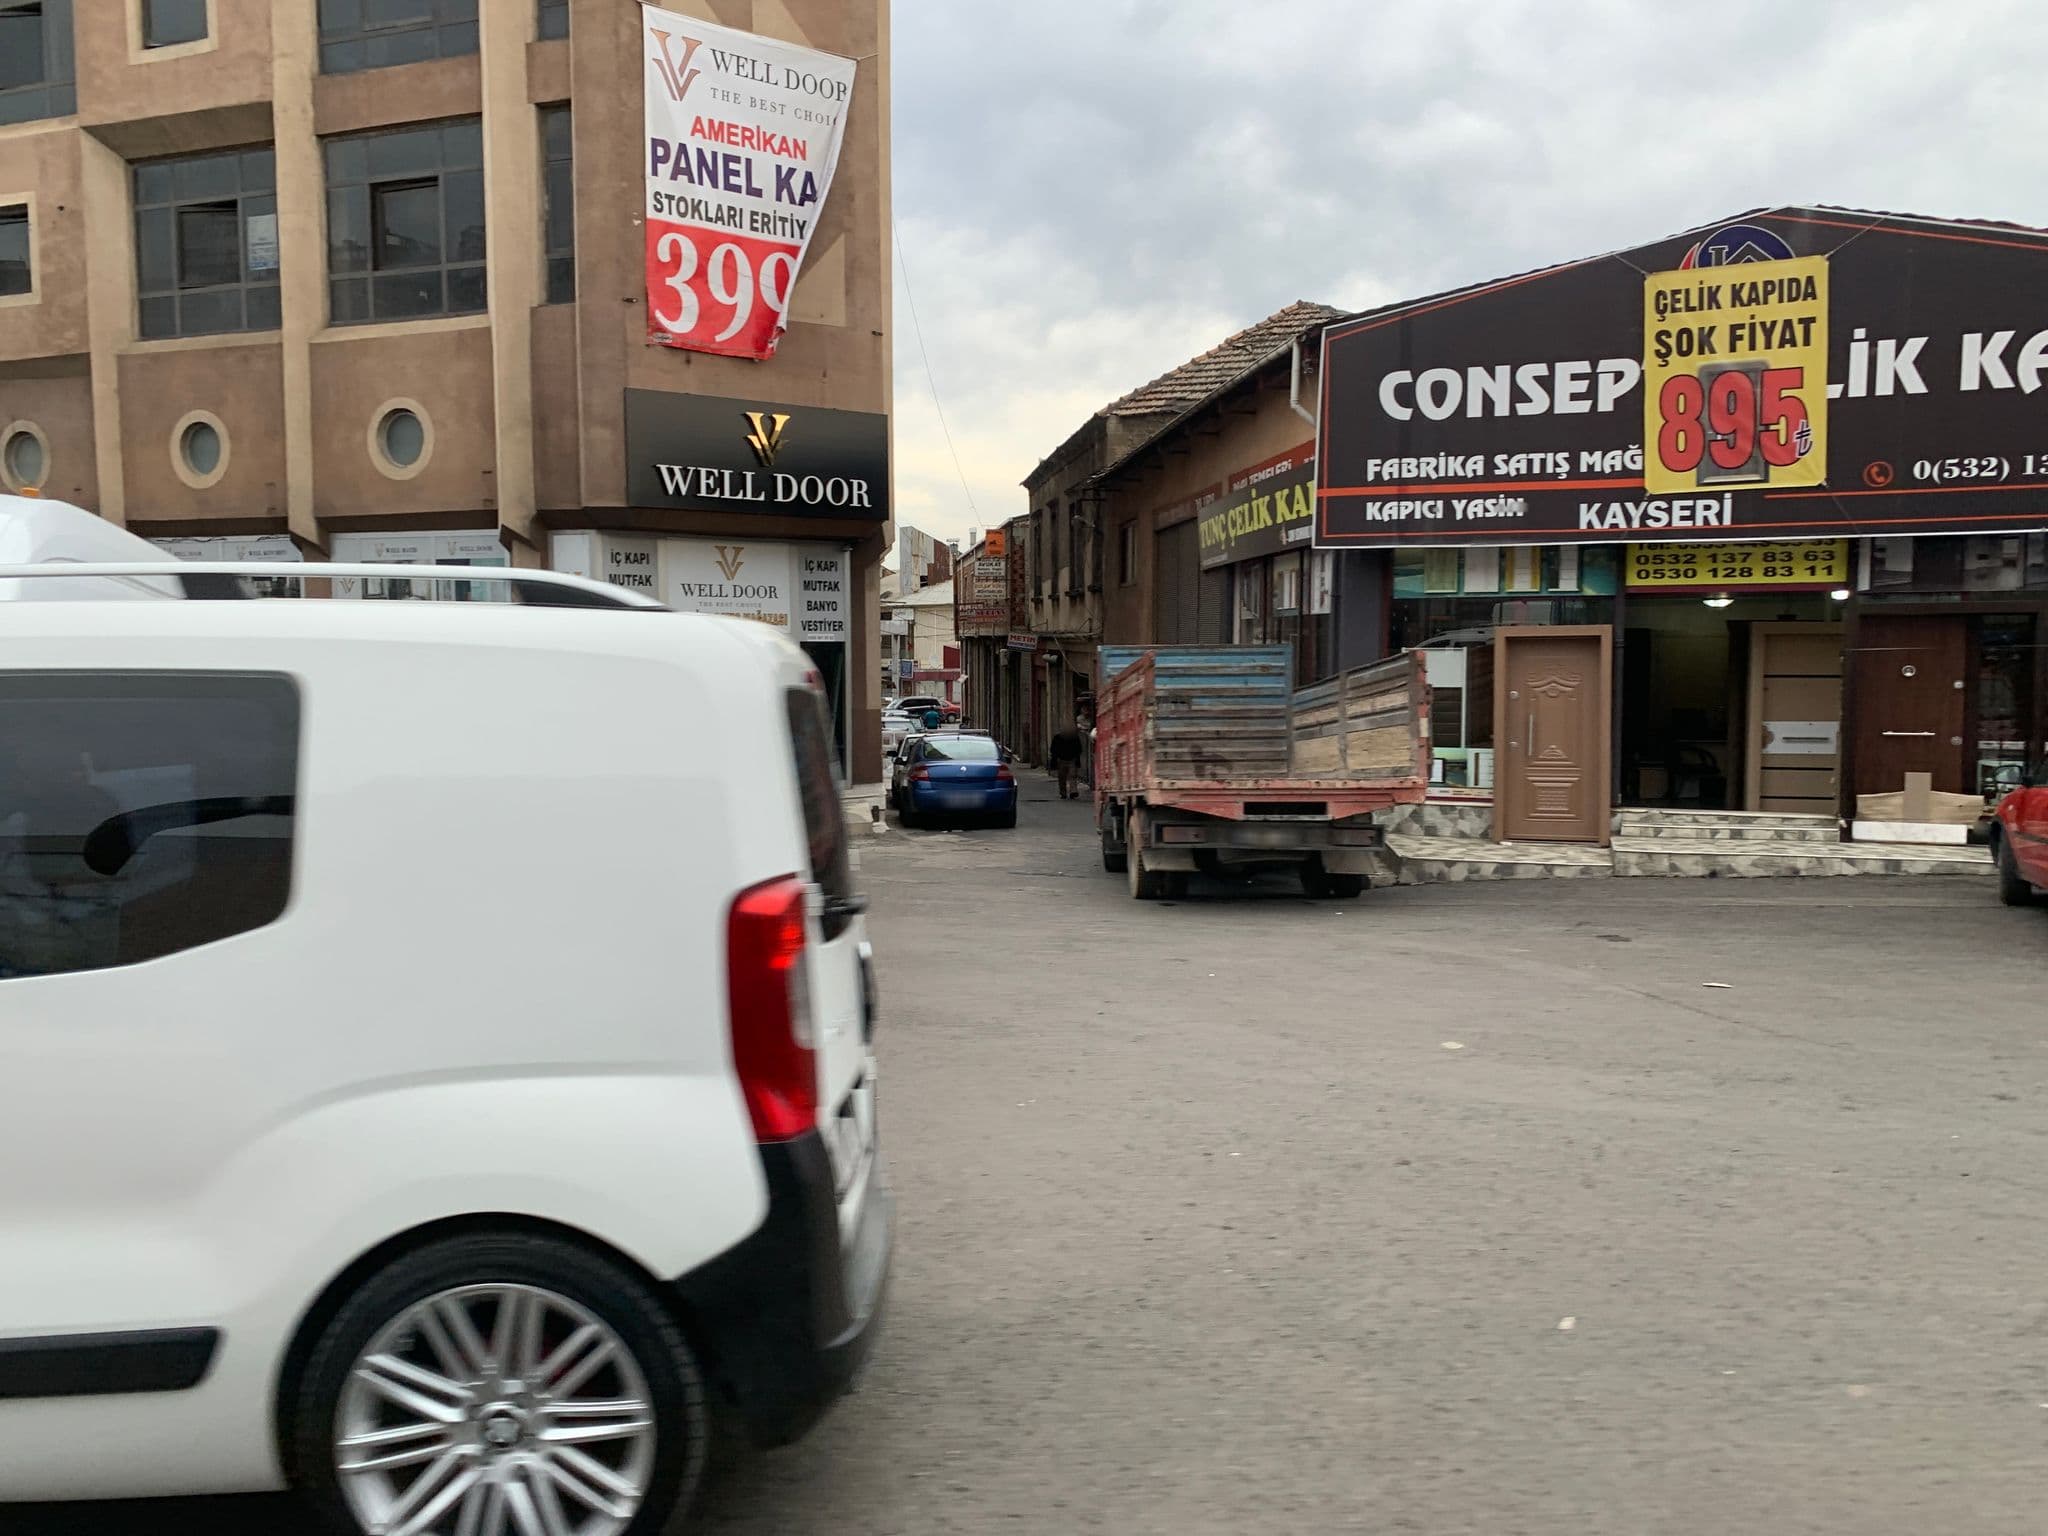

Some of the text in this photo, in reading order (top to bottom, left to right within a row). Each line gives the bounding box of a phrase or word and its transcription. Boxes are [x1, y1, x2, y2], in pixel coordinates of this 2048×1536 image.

[710, 49, 778, 86] WELL
[710, 87, 741, 105] THE
[750, 96, 787, 115] BEST
[690, 115, 807, 161] AMERİKAN
[650, 137, 763, 198] PANEL
[653, 191, 744, 229] STOKLARI
[1655, 276, 1818, 322] ÇELİK KAPIDA
[1654, 314, 1817, 367] ŞOK FİYAT
[1378, 358, 1645, 421] CONSEP
[1366, 451, 1485, 482] FABRİKA
[1493, 451, 1571, 479] SATIŞ
[1913, 456, 2010, 485] 0(532)
[656, 464, 872, 508] WELL DOOR
[1200, 513, 1227, 550] TUNÇ
[1228, 488, 1273, 547] ÇELİK
[1366, 499, 1444, 522] KAPICI
[1579, 493, 1733, 530] KAYSERİ
[610, 548, 650, 566] İÇ KAPI
[804, 557, 838, 574] İÇ KAPI
[1635, 550, 1835, 565] 0532 137 83 63
[1636, 565, 1834, 579] 0530 128 83 11
[608, 573, 652, 587] MUTFAK
[680, 583, 778, 599] WELL DOOR
[803, 580, 840, 592] MUTFAK
[807, 600, 838, 612] BANYO
[801, 617, 844, 632] VESTİYER
